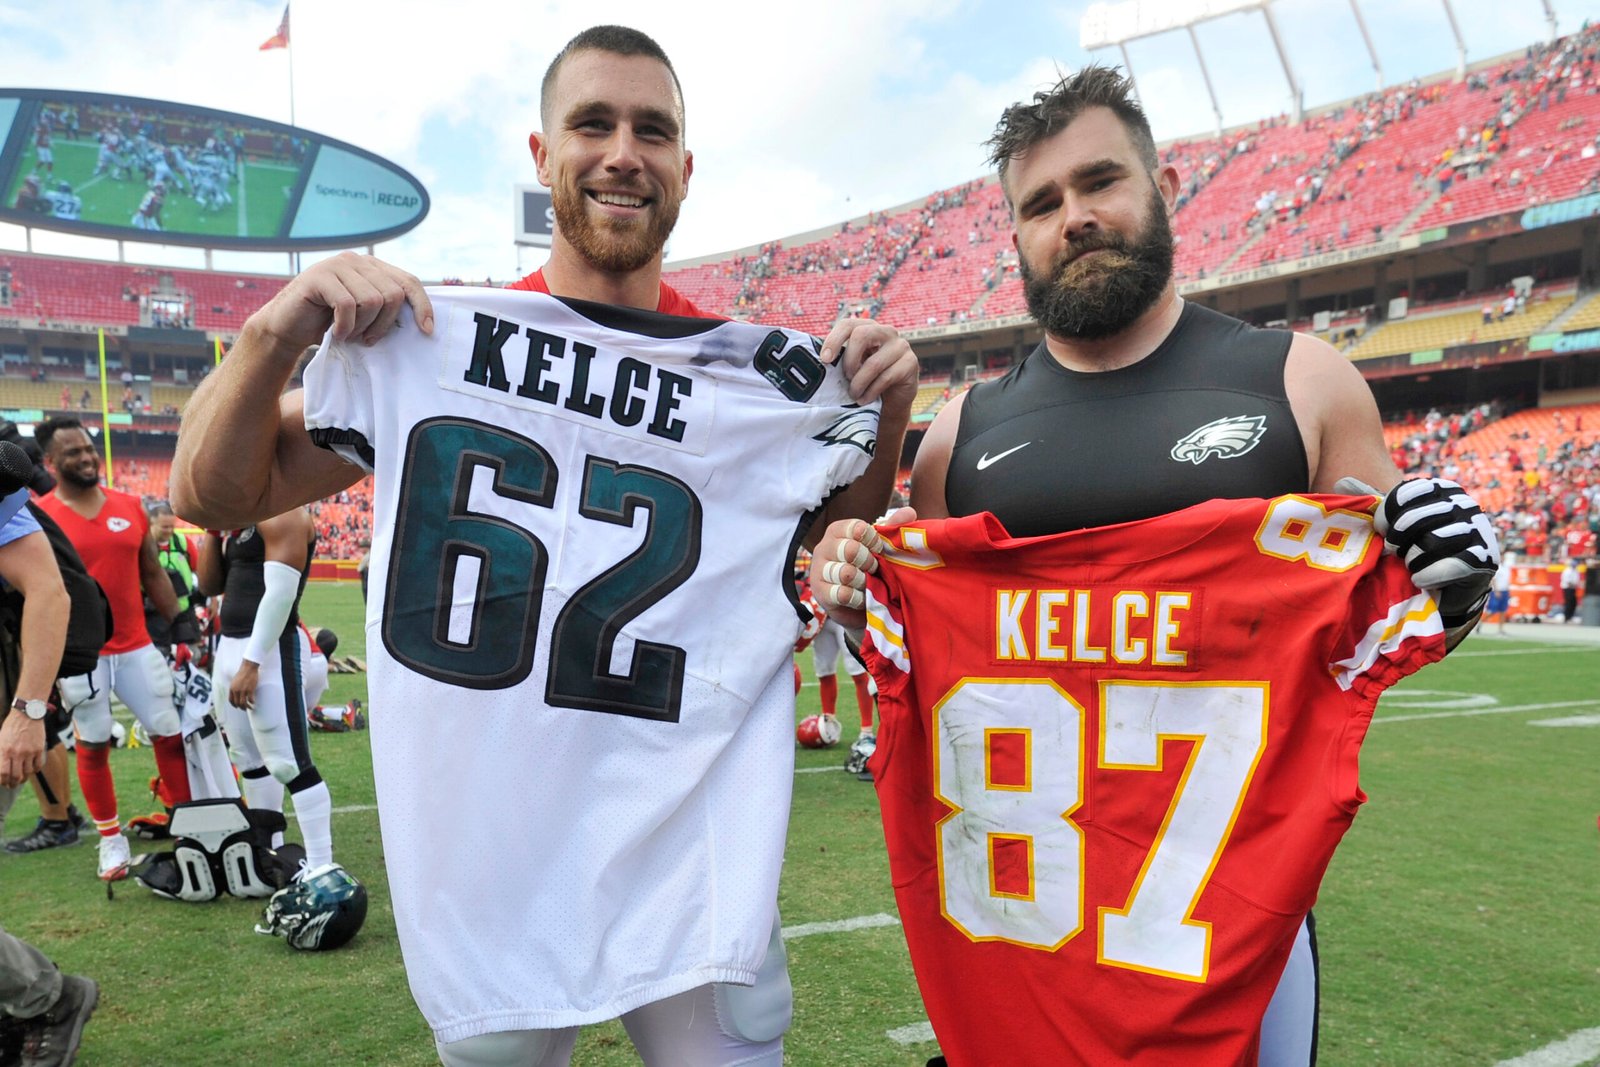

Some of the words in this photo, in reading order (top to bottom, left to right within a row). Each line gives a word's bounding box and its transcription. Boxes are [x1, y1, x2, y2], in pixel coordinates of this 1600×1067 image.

[56, 199, 76, 214] 27
[316, 184, 369, 199] Spectrum
[377, 192, 418, 207] RECAP
[464, 312, 692, 442] KELCE
[381, 415, 703, 723] 62
[996, 588, 1192, 666] KELCE
[188, 674, 212, 704] 58
[932, 677, 1270, 983] 87
